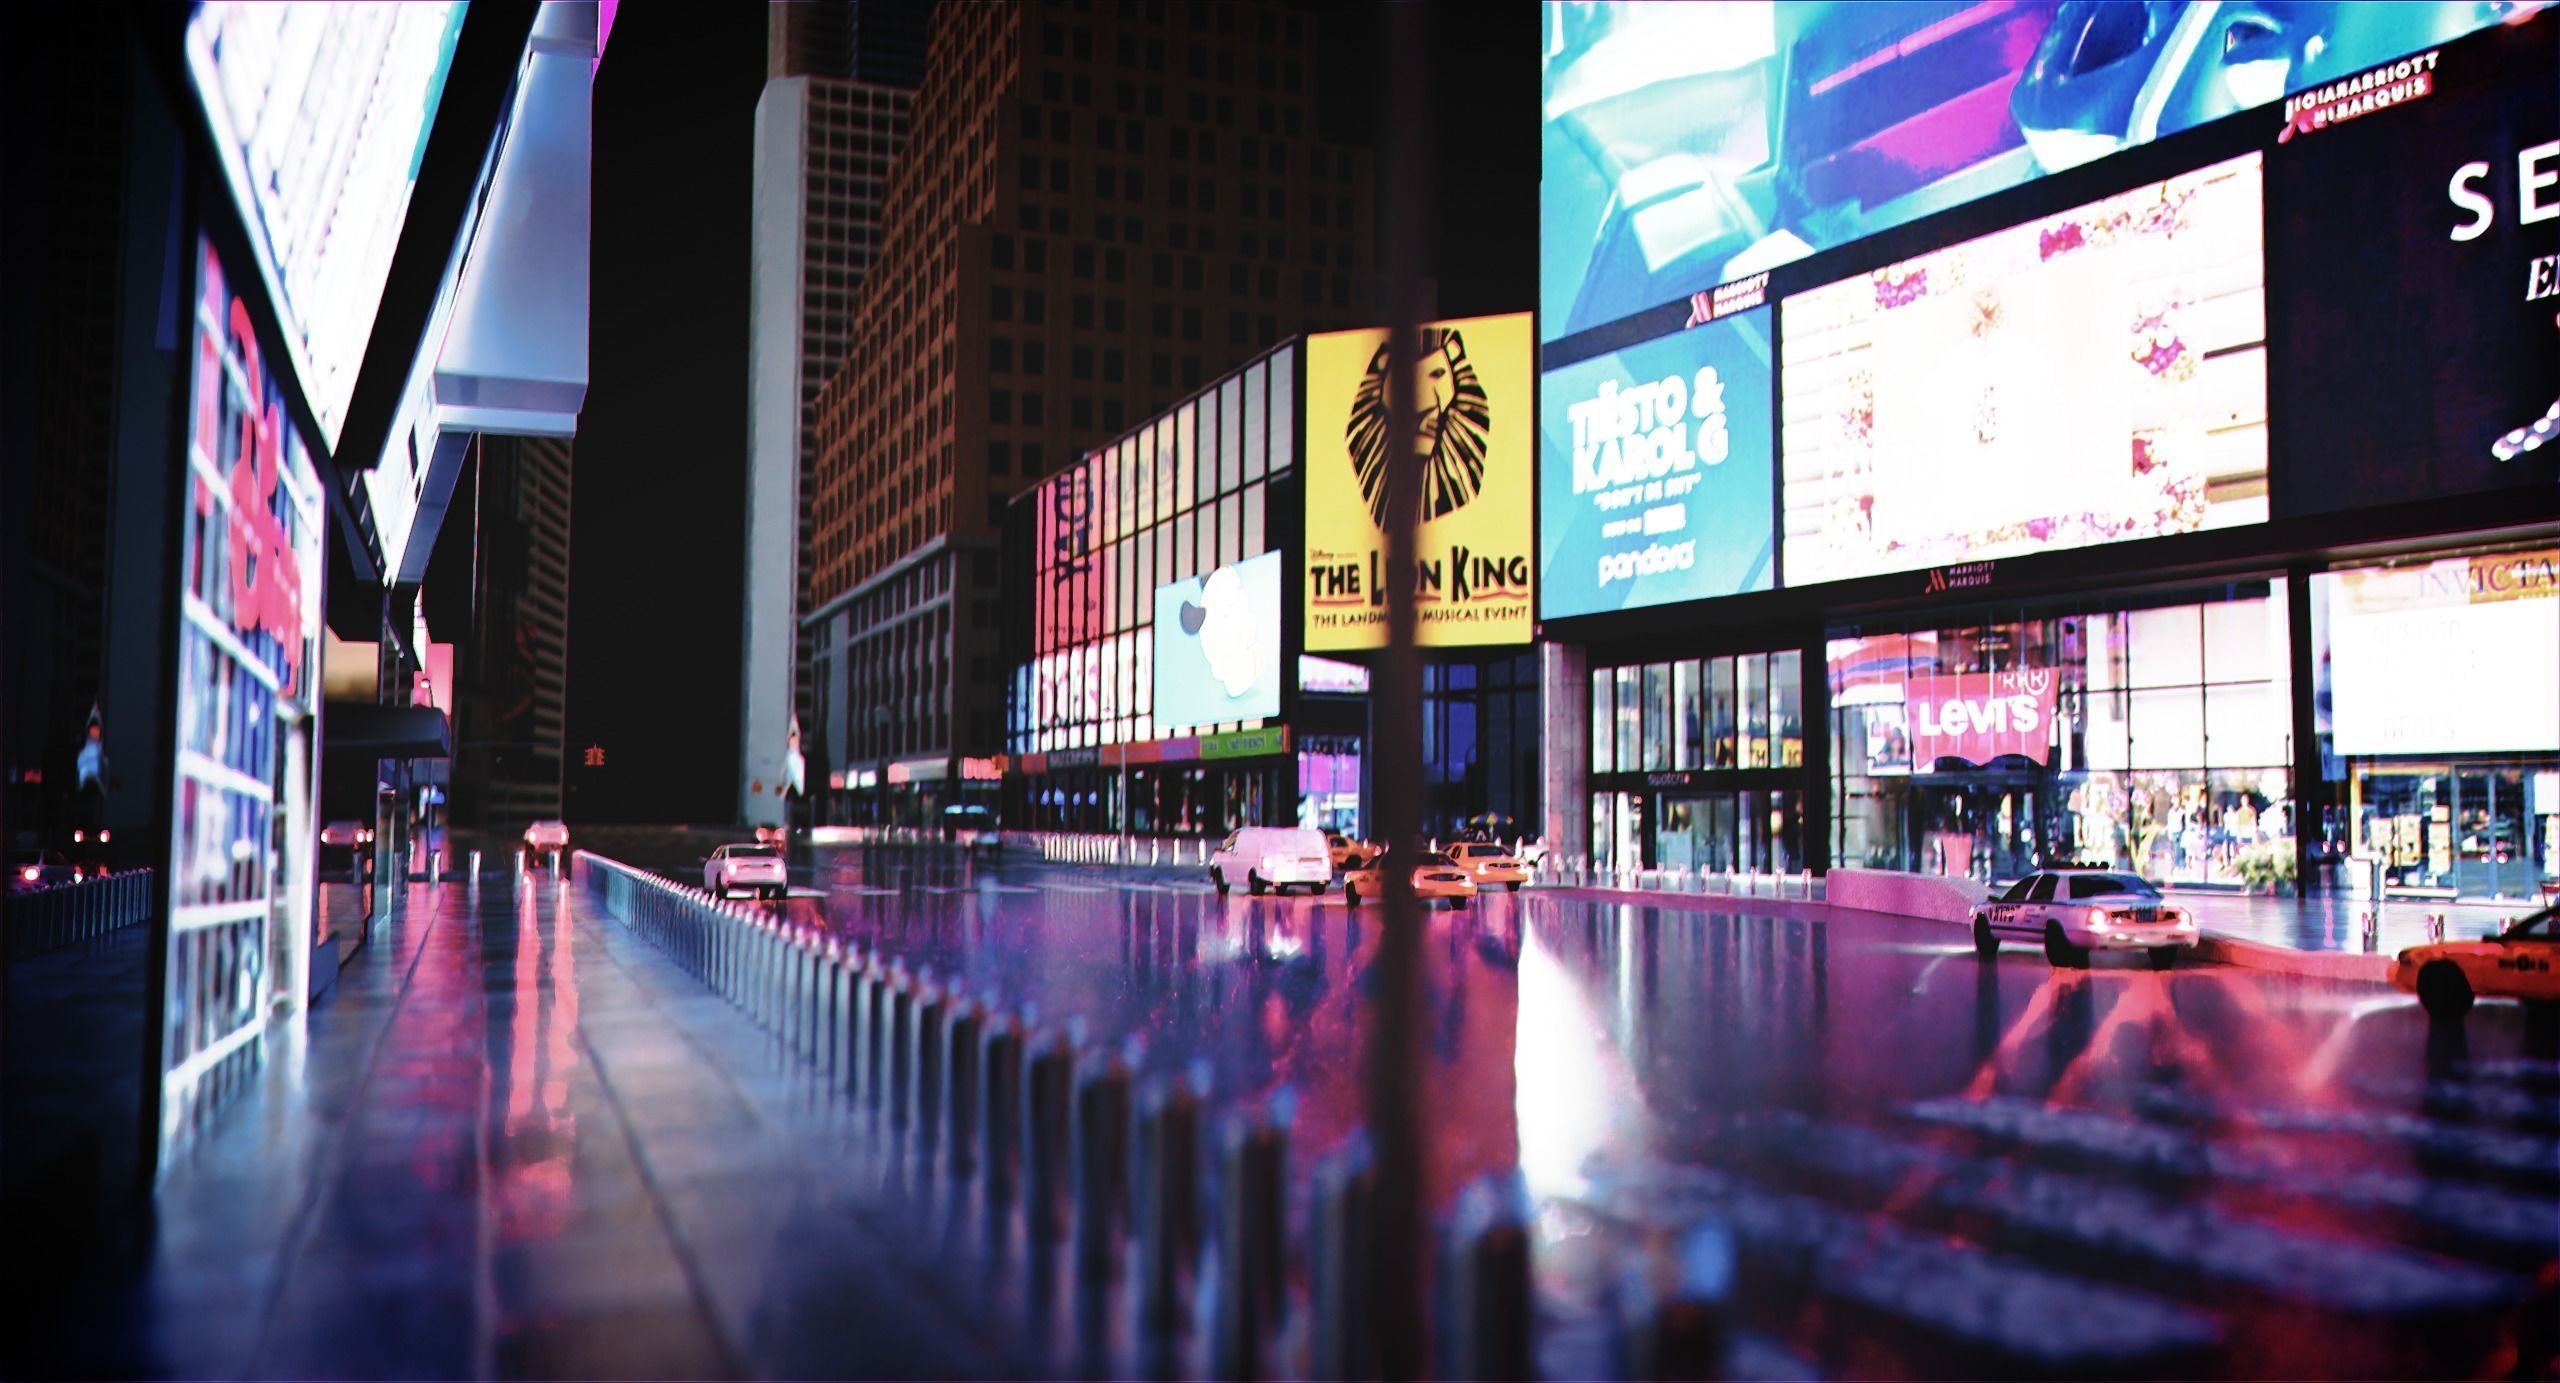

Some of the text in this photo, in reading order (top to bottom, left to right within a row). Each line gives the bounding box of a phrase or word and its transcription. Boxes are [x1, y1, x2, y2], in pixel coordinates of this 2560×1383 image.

[1691, 365, 1726, 419] &
[1572, 412, 1730, 496] KAROL G
[1310, 545, 1529, 606] THE LN KING
[1598, 538, 1697, 588] pandora
[1948, 561, 1996, 576] MARRIOTT
[1948, 573, 1991, 588] MARQUIS
[2418, 556, 2558, 599] INVICTA
[1313, 613, 1338, 629] THE
[1421, 608, 1481, 626] MUSICAL
[1484, 605, 1528, 622] EVENT
